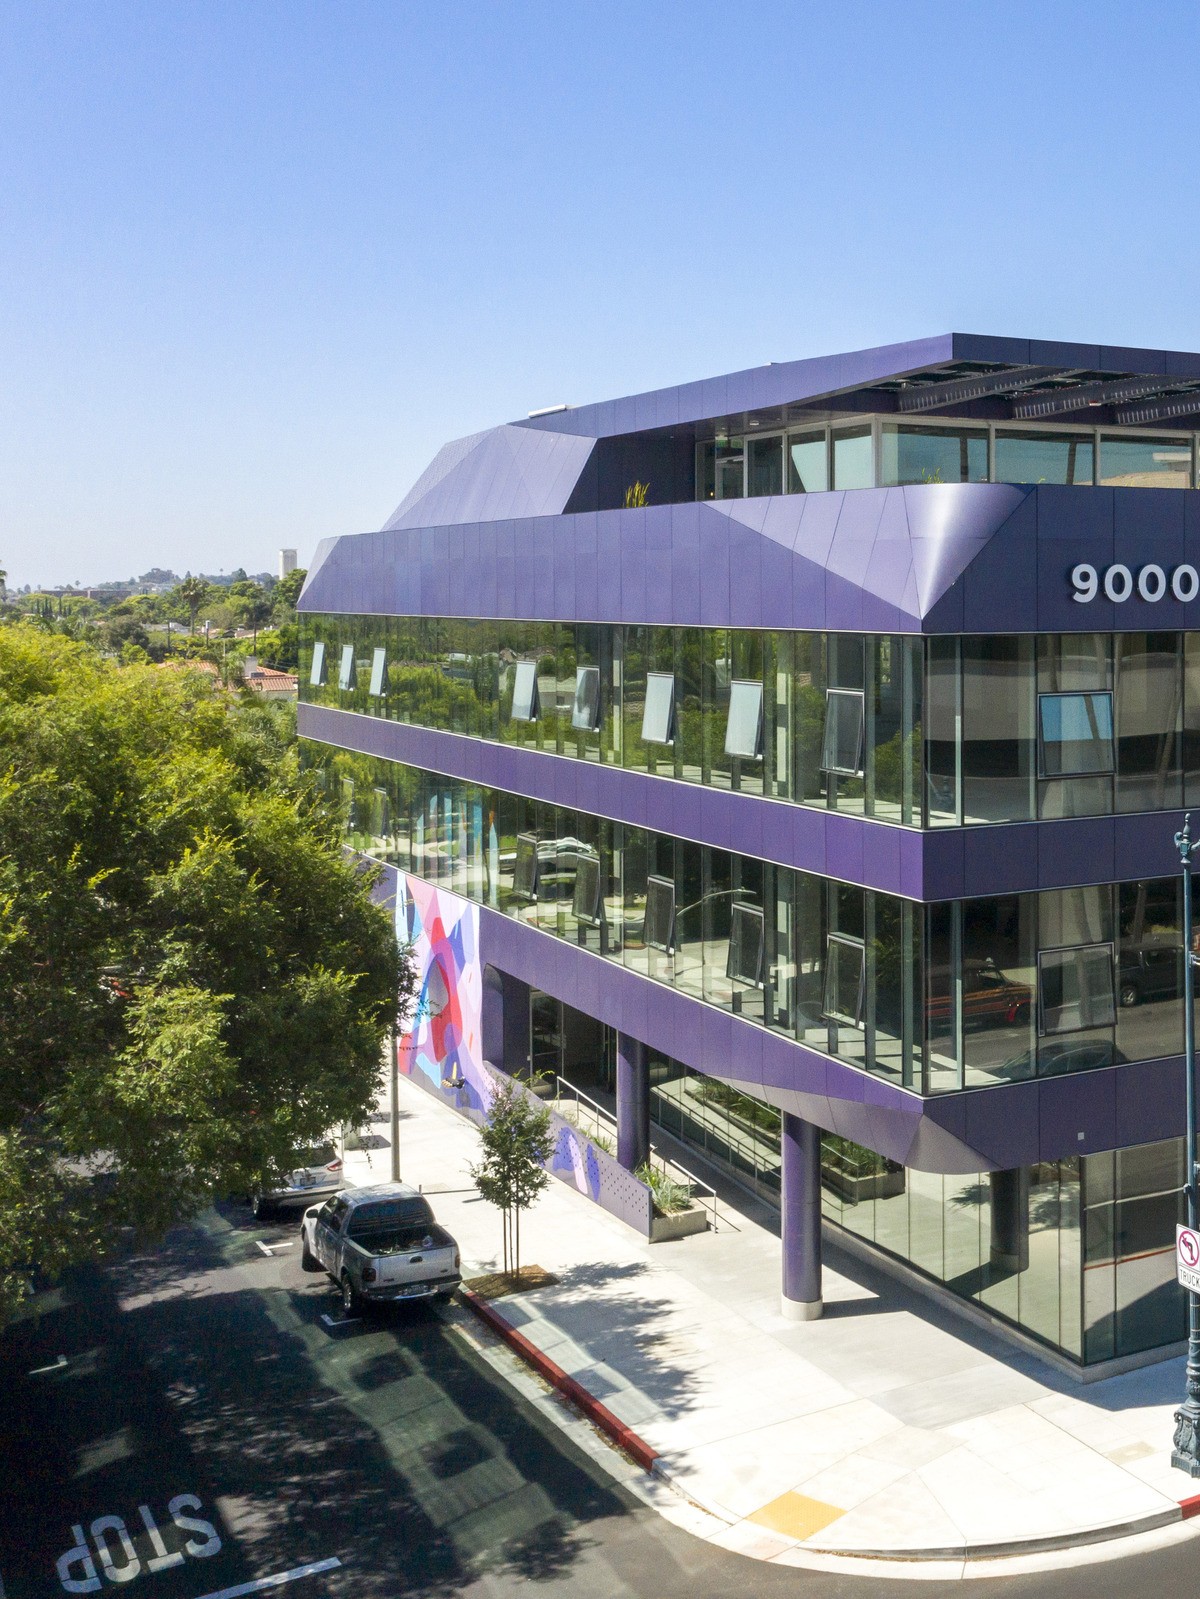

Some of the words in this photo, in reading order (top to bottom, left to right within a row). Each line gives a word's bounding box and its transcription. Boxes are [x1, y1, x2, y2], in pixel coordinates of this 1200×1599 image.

[1071, 563, 1199, 603] 9000
[1179, 1268, 1200, 1288] TRUCK
[56, 1493, 222, 1593] STOP
